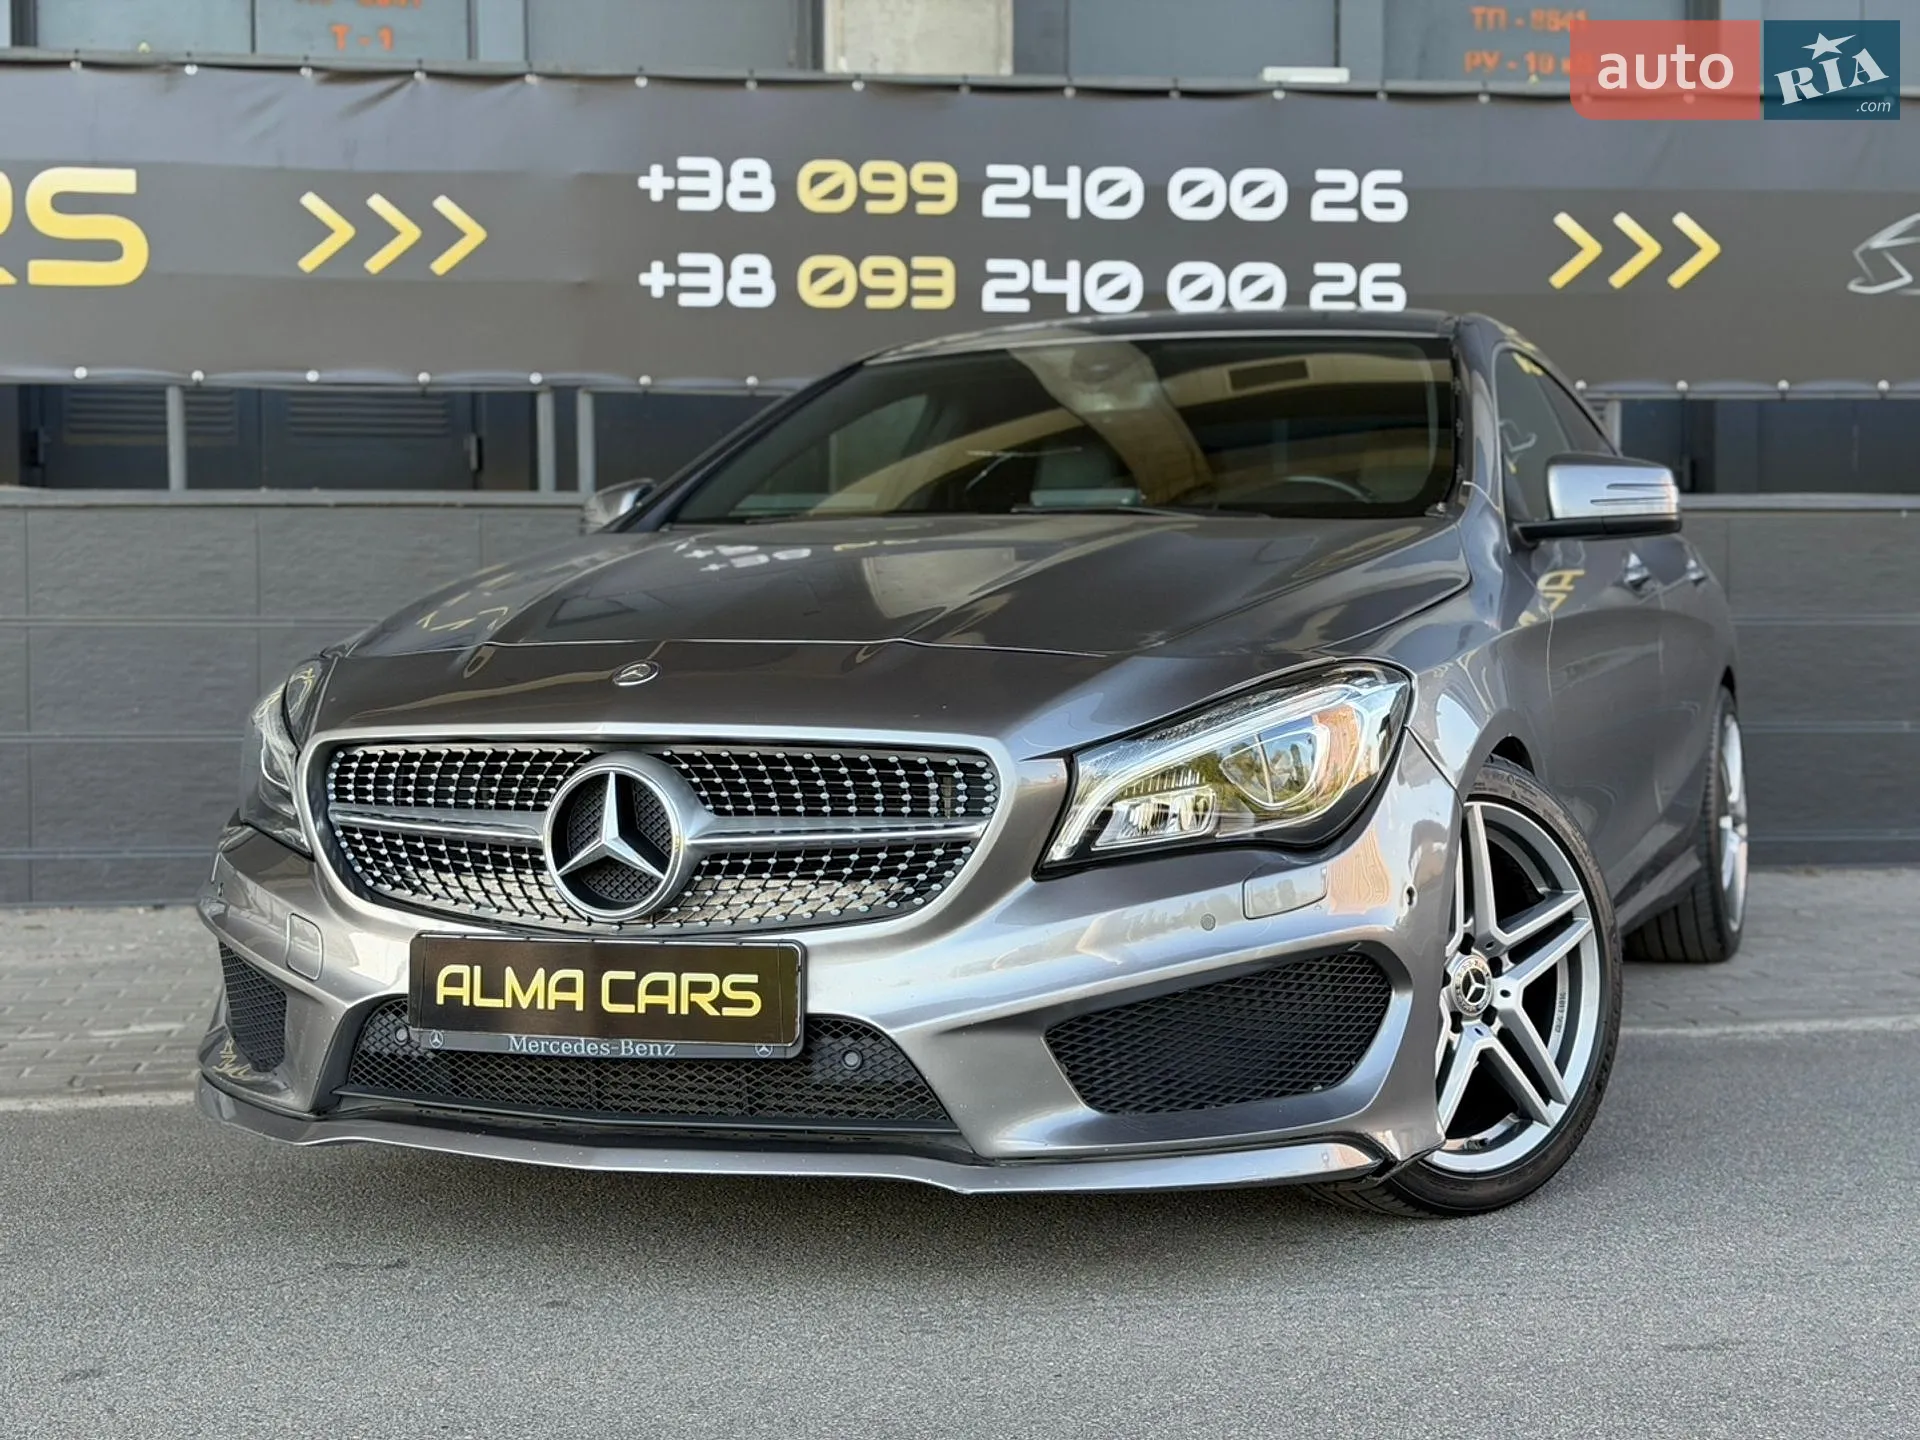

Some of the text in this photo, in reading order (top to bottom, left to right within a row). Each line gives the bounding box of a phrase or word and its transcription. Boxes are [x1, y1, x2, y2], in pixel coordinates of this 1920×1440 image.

[638, 156, 1409, 222] +38 099 240 00 26
[0, 167, 150, 286] S
[639, 252, 1407, 313] +38 093 240 00 26
[436, 965, 762, 1018] ALMA CARS
[508, 1035, 677, 1057] Mercedes-Benz
